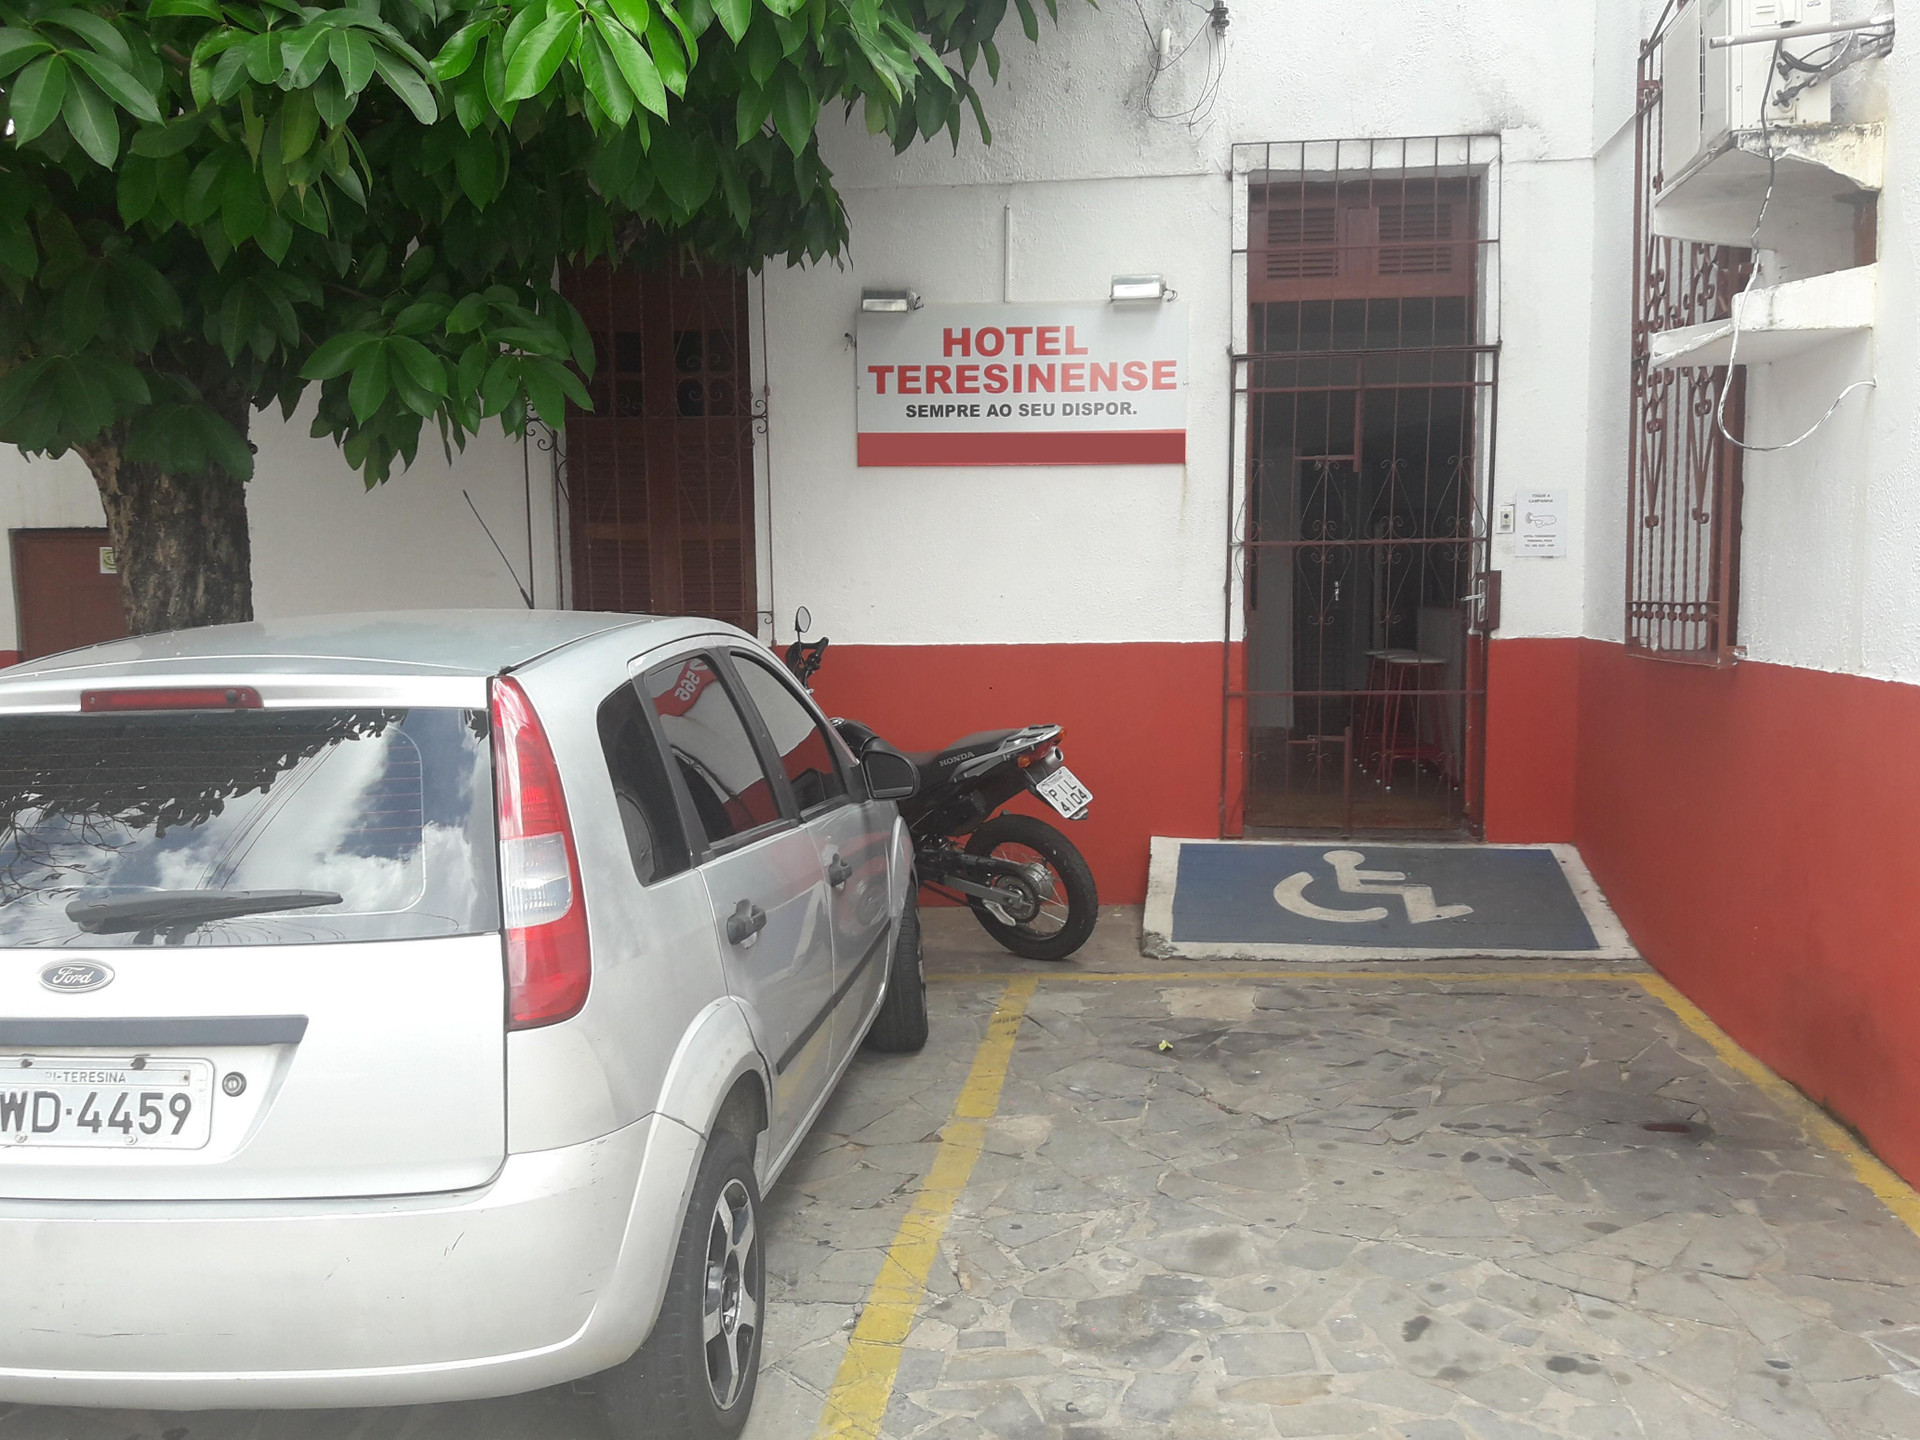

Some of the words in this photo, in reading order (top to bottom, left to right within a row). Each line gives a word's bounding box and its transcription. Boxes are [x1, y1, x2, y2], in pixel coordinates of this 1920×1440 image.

[942, 326, 1089, 358] HOTEL
[867, 359, 1178, 395] TERESINENSE
[905, 404, 981, 418] SEMPRE
[986, 403, 1013, 418] AO
[1018, 403, 1055, 417] SEU
[1061, 401, 1138, 417] DISPOR.
[939, 751, 976, 767] HONDA
[1048, 779, 1077, 802] PIL
[1060, 788, 1089, 812] 4104
[52, 966, 94, 985] Ford
